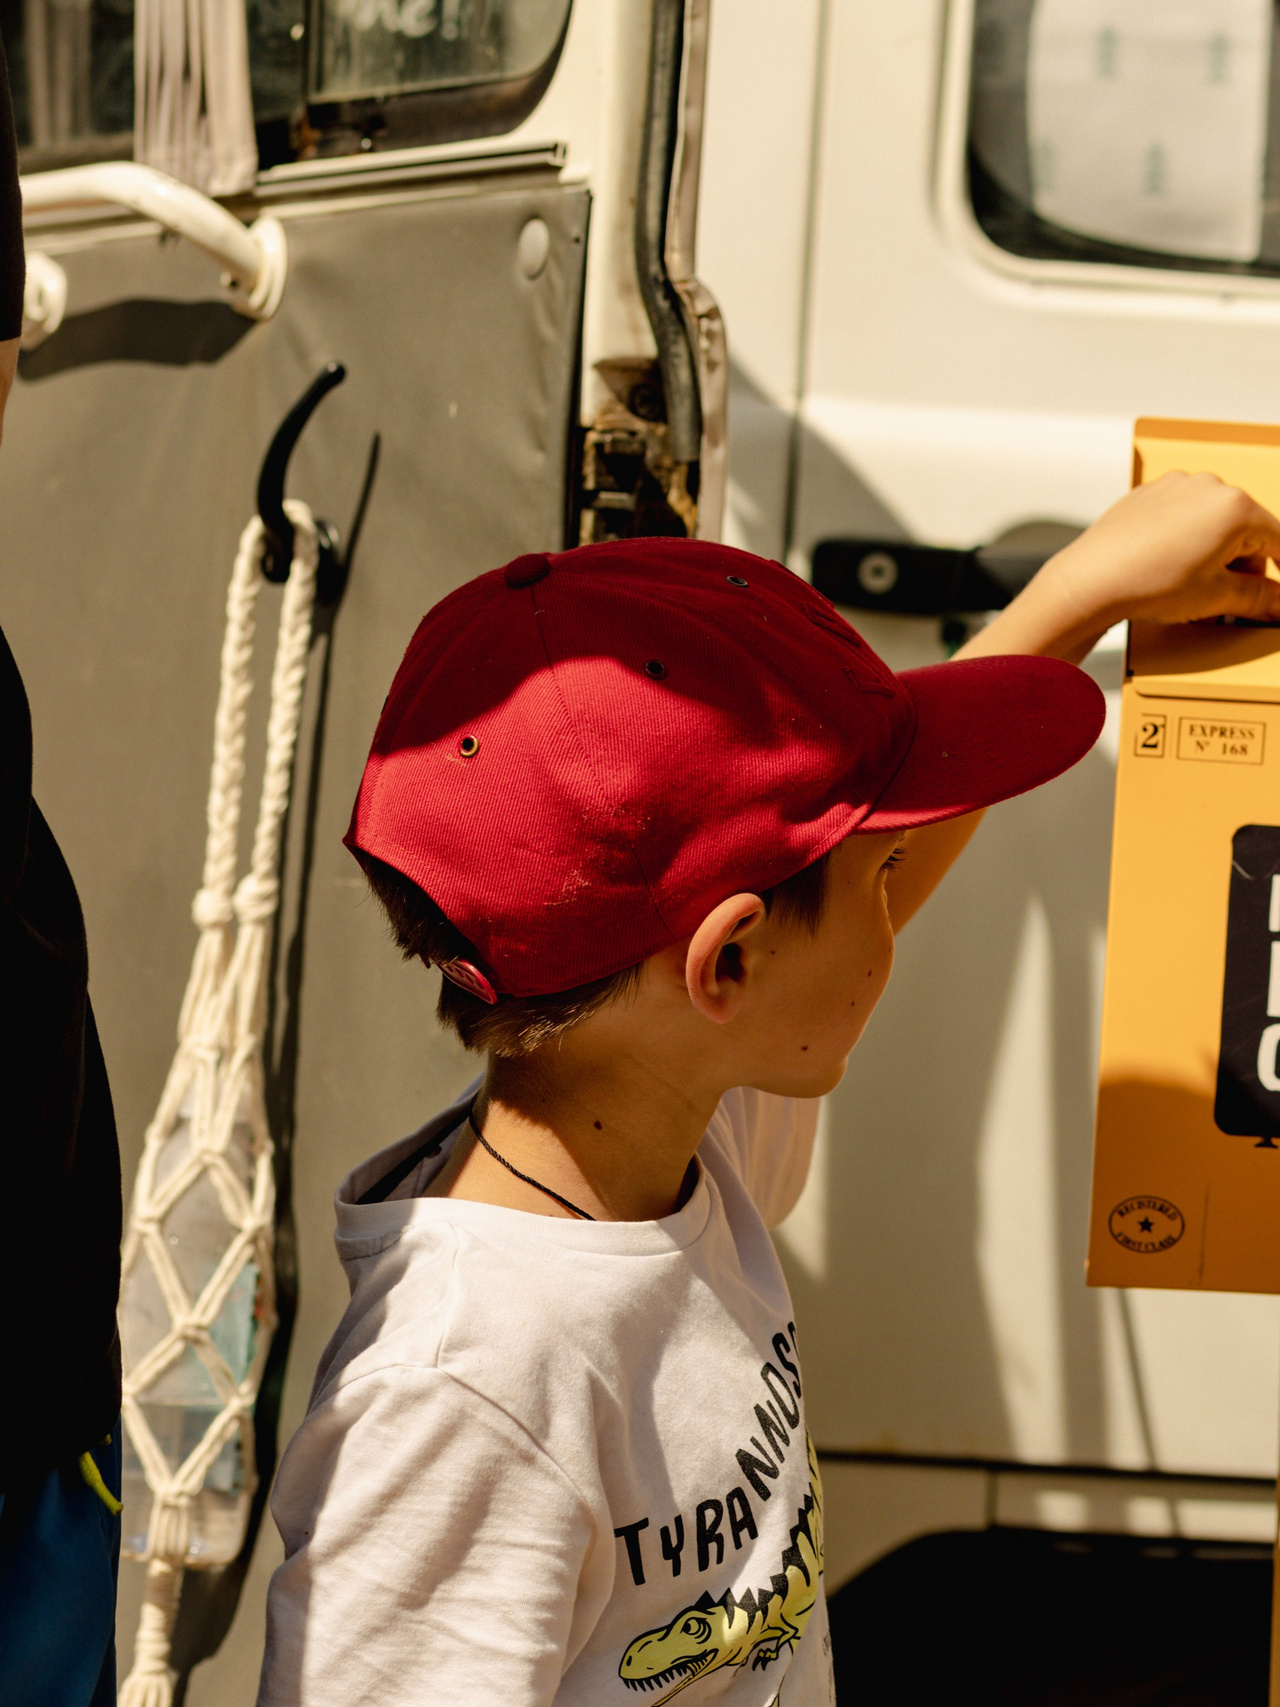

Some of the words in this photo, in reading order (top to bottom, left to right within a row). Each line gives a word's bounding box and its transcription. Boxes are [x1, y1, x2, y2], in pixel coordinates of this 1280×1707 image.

[1141, 722, 1159, 749] 2
[1188, 723, 1256, 740] EXPRESS
[1222, 742, 1249, 756] 168
